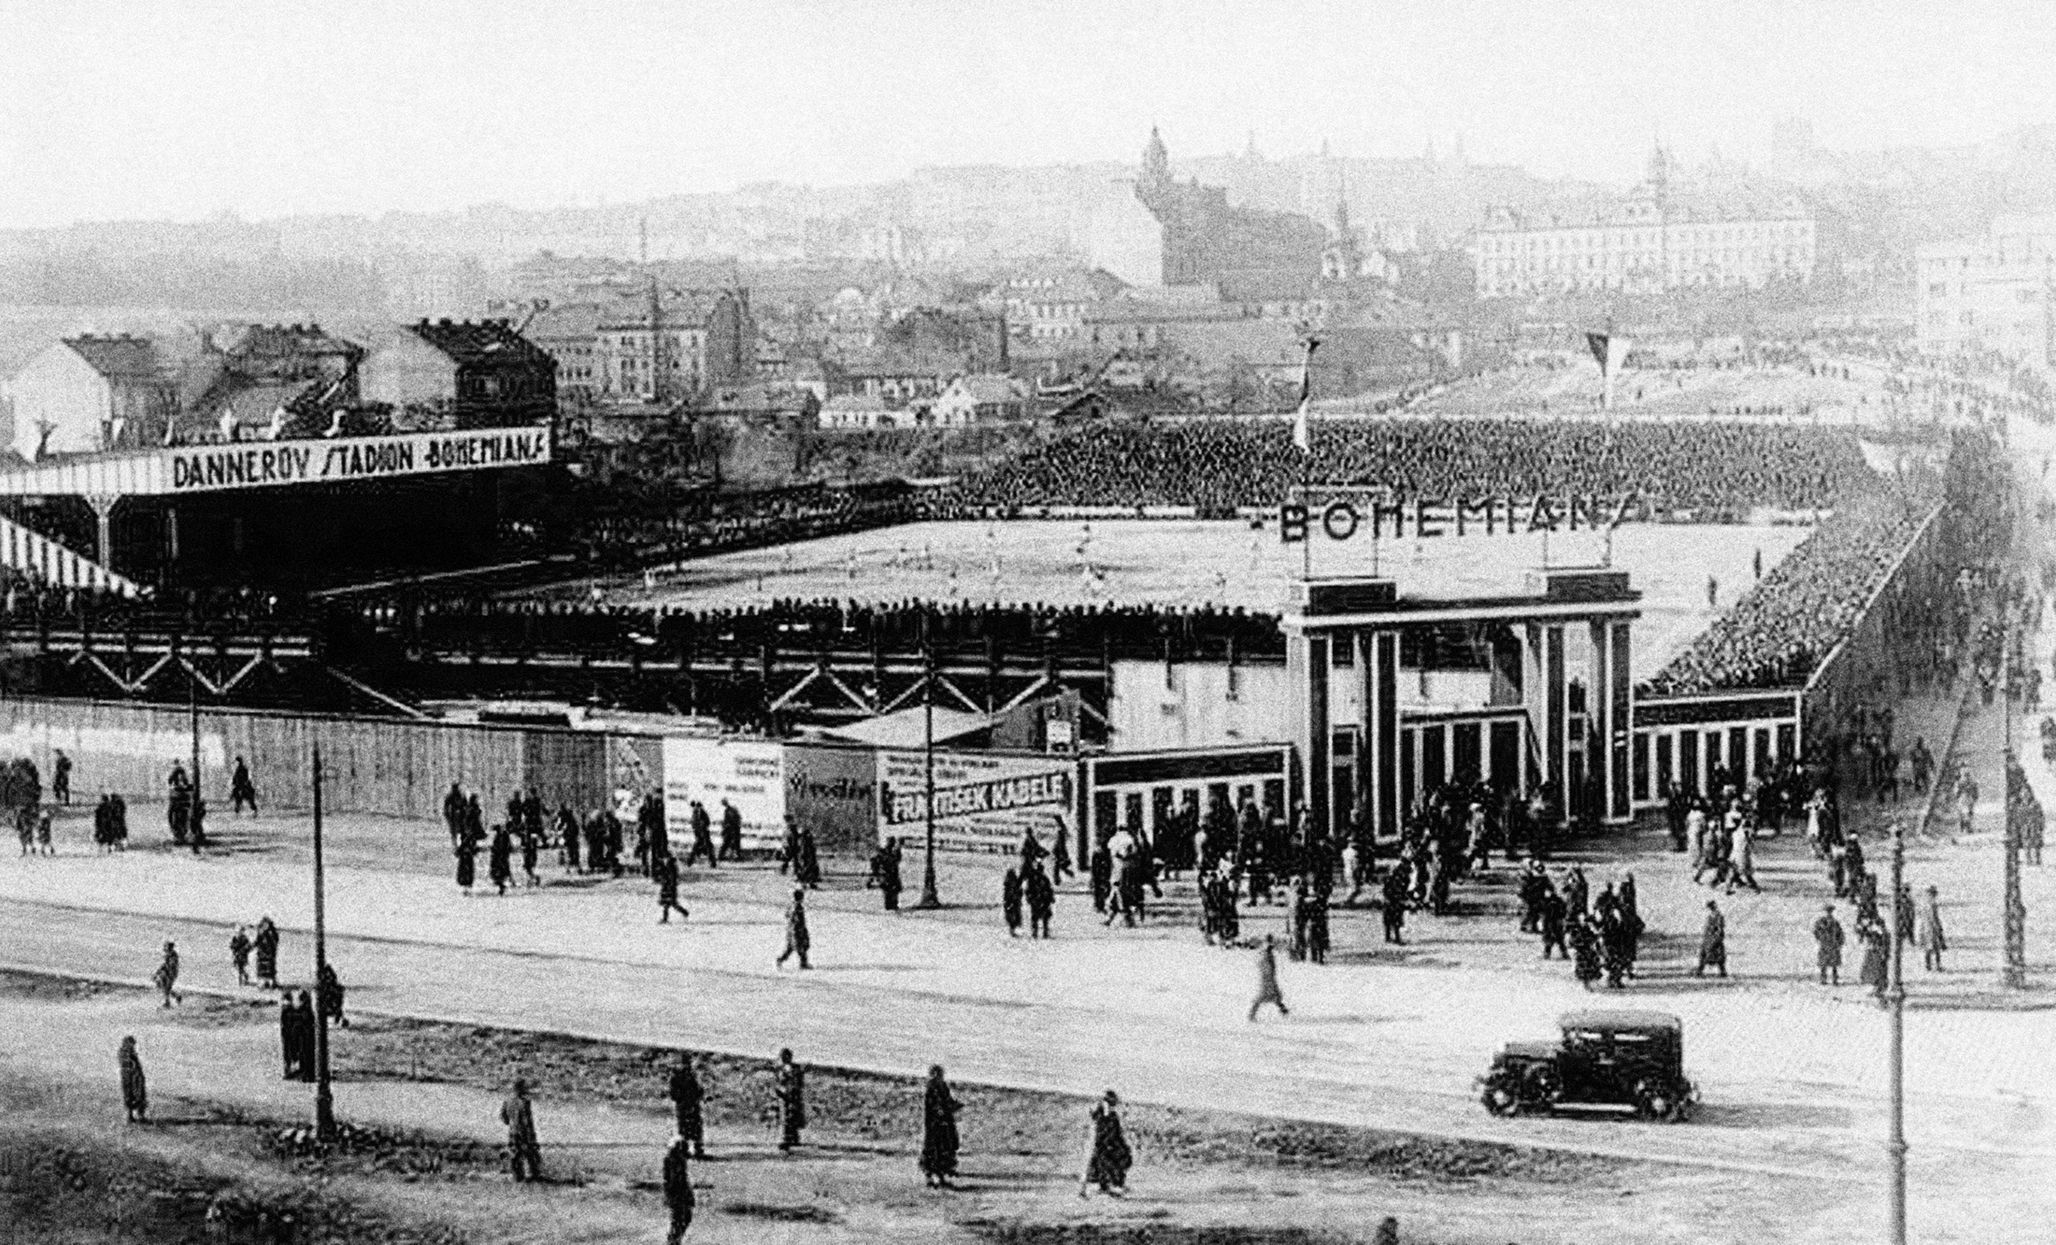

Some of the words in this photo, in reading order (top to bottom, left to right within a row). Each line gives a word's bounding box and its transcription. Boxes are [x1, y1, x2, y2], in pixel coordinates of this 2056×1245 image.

[320, 441, 414, 477] STADION
[424, 433, 544, 468] BOHEMIANS
[1281, 494, 1637, 542] BOHEMIANS
